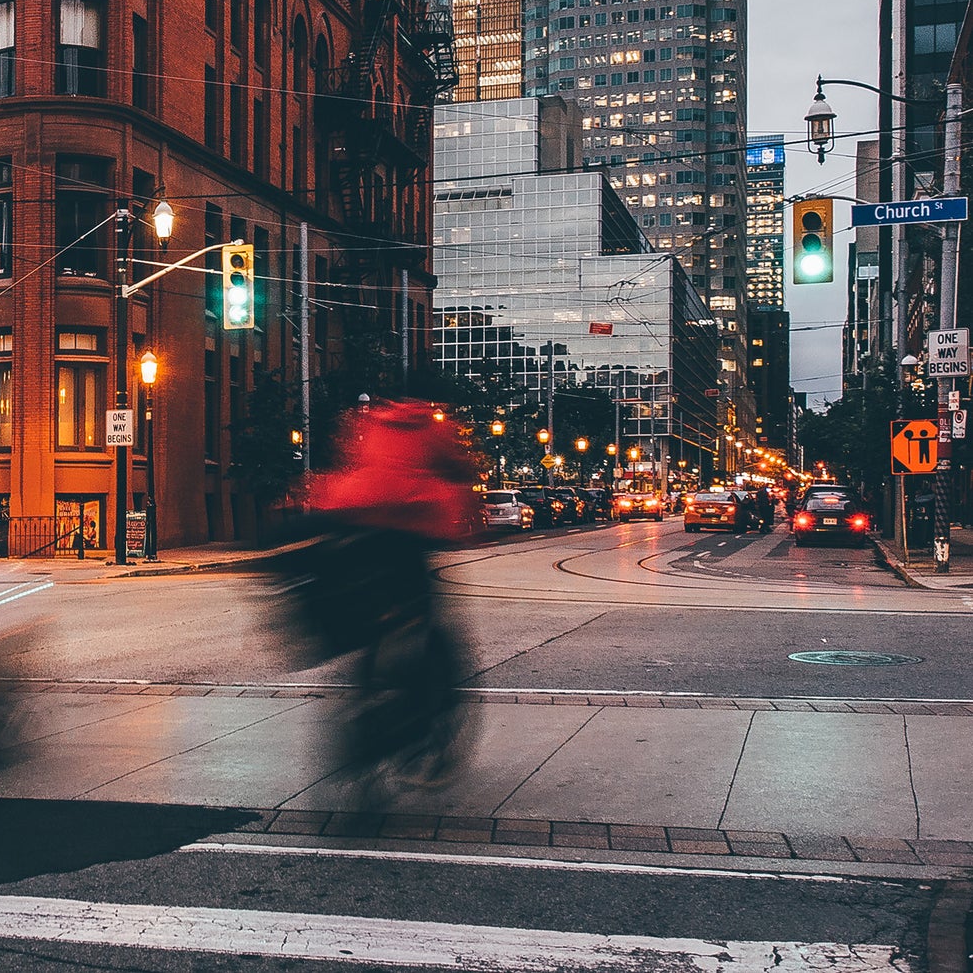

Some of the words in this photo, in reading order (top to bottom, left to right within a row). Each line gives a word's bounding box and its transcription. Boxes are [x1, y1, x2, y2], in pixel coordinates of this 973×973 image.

[874, 202, 930, 220] Church
[934, 201, 943, 210] St
[937, 332, 958, 344] ONE
[937, 347, 959, 359] WAY
[929, 361, 967, 374] BEGINS
[112, 412, 127, 421] ONE
[112, 423, 127, 432] WAY
[107, 434, 132, 443] BEGINS
